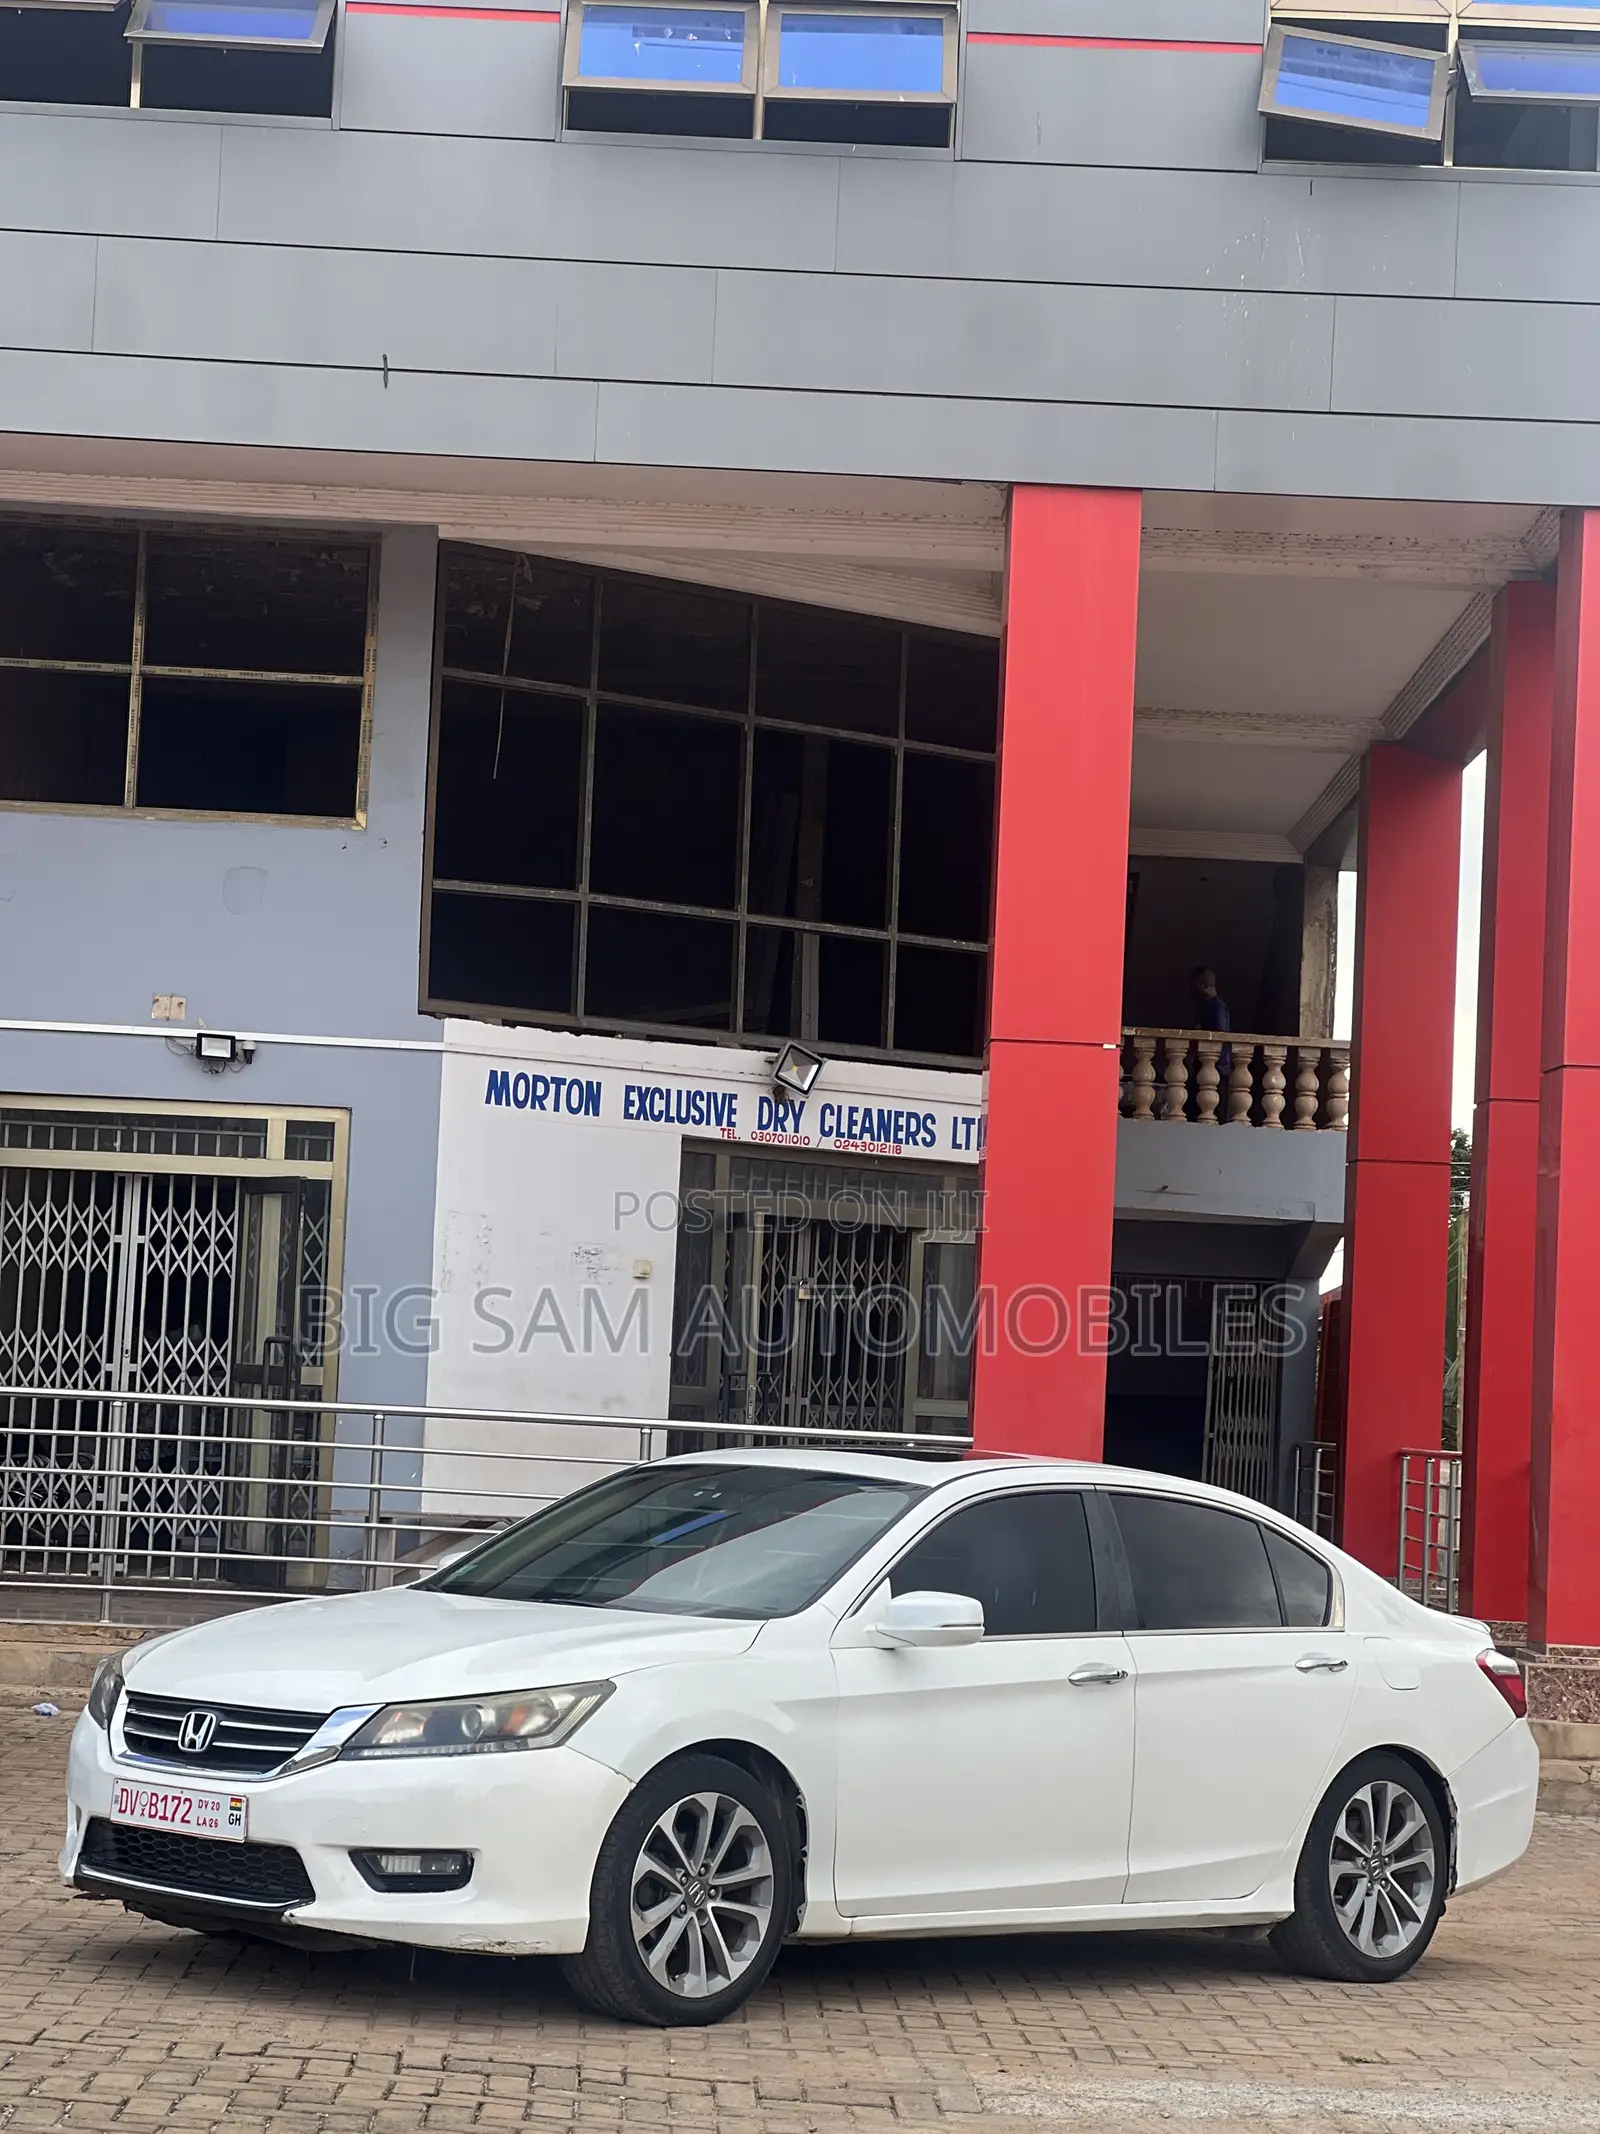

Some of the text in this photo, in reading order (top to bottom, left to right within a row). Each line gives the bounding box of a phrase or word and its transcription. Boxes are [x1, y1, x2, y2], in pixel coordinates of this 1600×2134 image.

[485, 1070, 602, 1117] MORTON
[623, 1085, 738, 1128] EXCLUSIVE
[758, 1096, 806, 1133] DRY
[819, 1103, 937, 1148] CLEANERS
[720, 1127, 742, 1140] TEL.
[750, 1131, 810, 1146] 0307011010
[834, 1139, 902, 1155] 0243012118
[228, 1812, 241, 1826] GH
